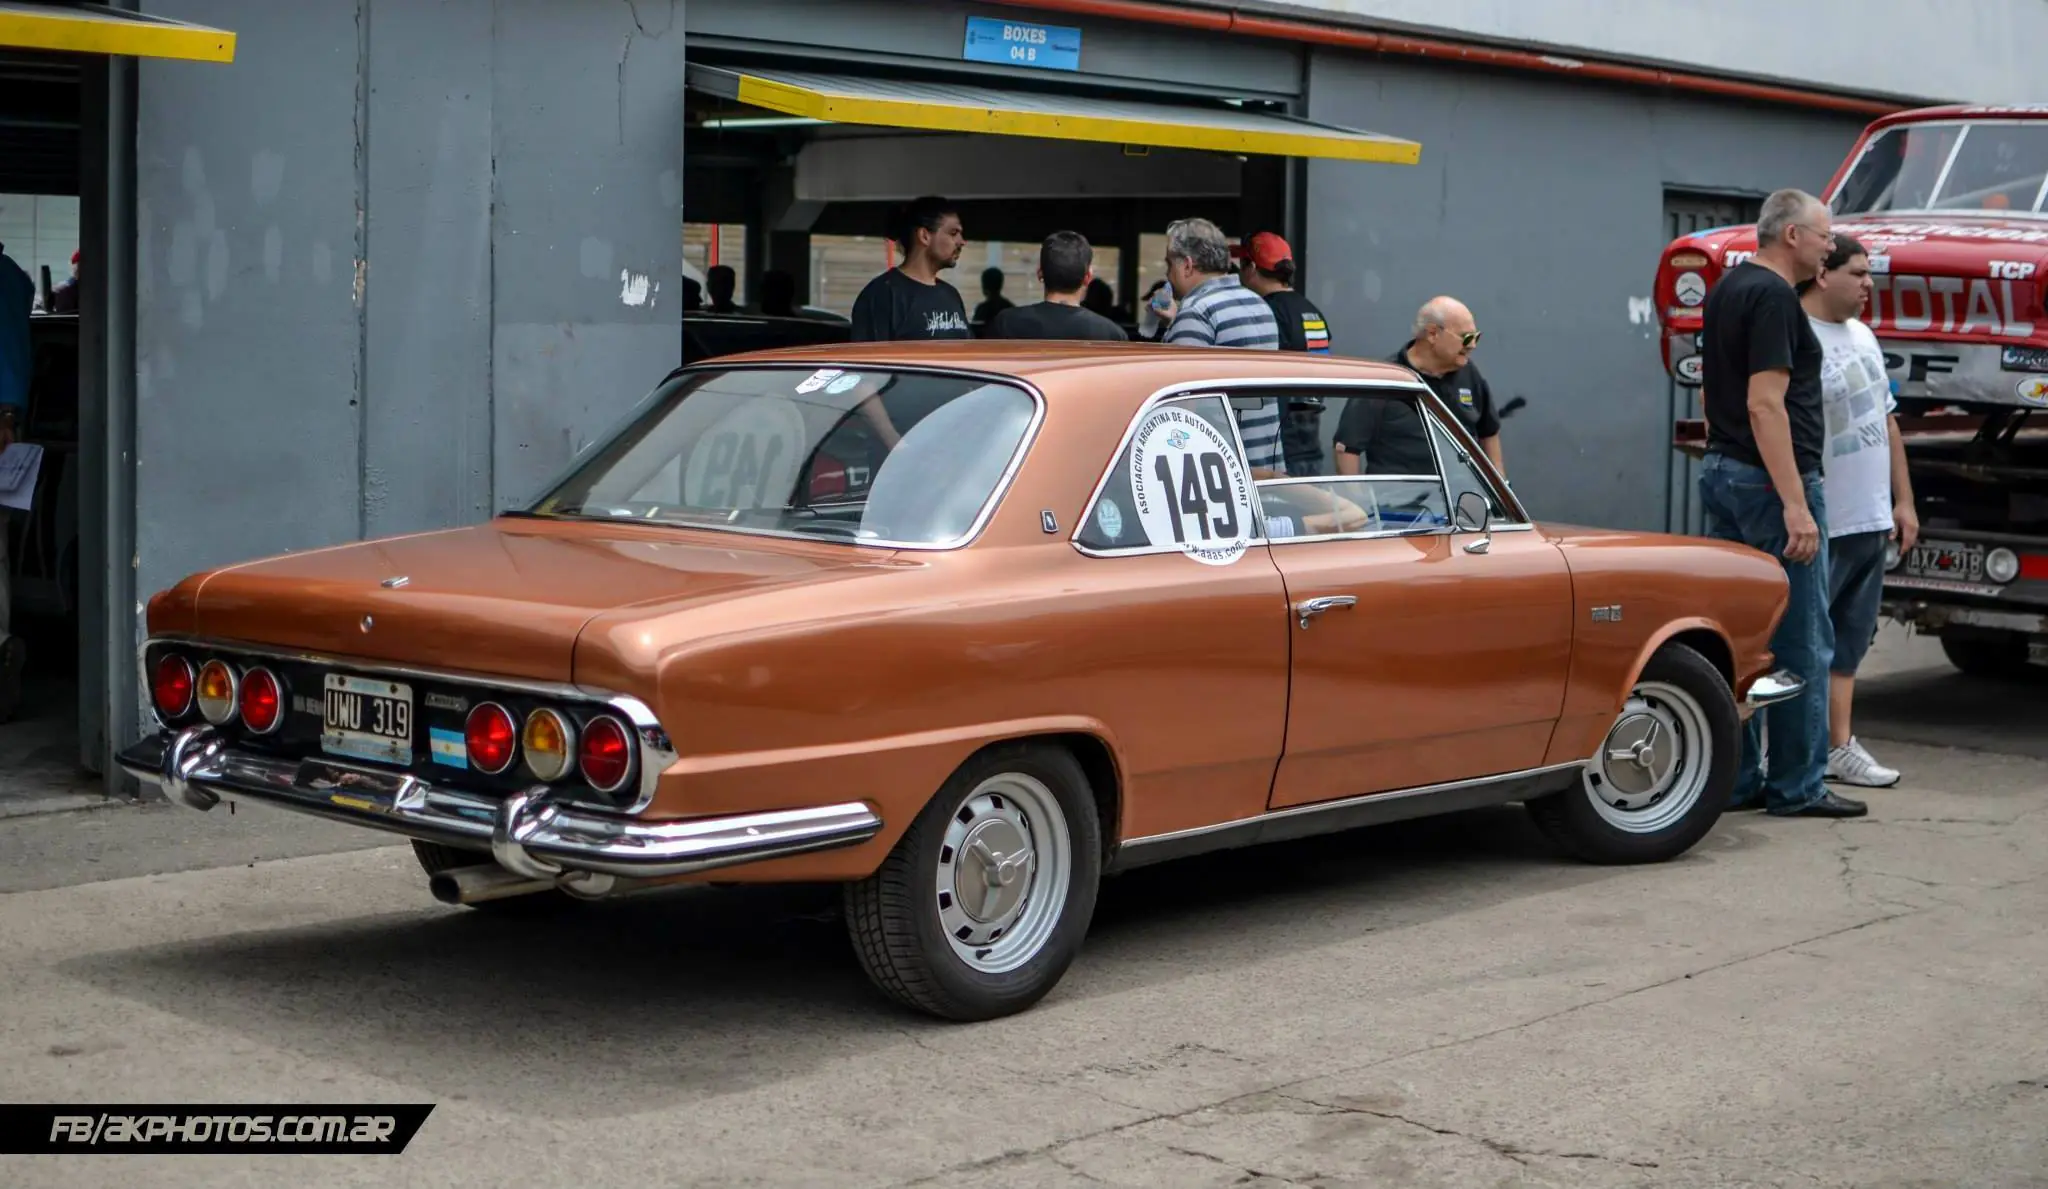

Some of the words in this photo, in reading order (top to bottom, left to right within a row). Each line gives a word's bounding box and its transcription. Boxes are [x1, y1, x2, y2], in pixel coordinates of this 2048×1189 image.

[1003, 24, 1047, 44] BOXES
[1010, 46, 1025, 60] 04
[1027, 47, 1036, 61] B
[1725, 251, 1757, 267] TC
[1988, 260, 2035, 279] TCP
[1870, 274, 2034, 336] TOTAL
[1138, 412, 1171, 447] ARGENTINA
[1171, 411, 1182, 422] DE
[1184, 415, 1236, 469] AUTOMOVILES
[1134, 447, 1150, 514] ASOCIACION
[1154, 452, 1239, 543] 149
[1233, 471, 1248, 508] SPORT
[327, 690, 361, 730] UWU
[372, 698, 408, 738] 319
